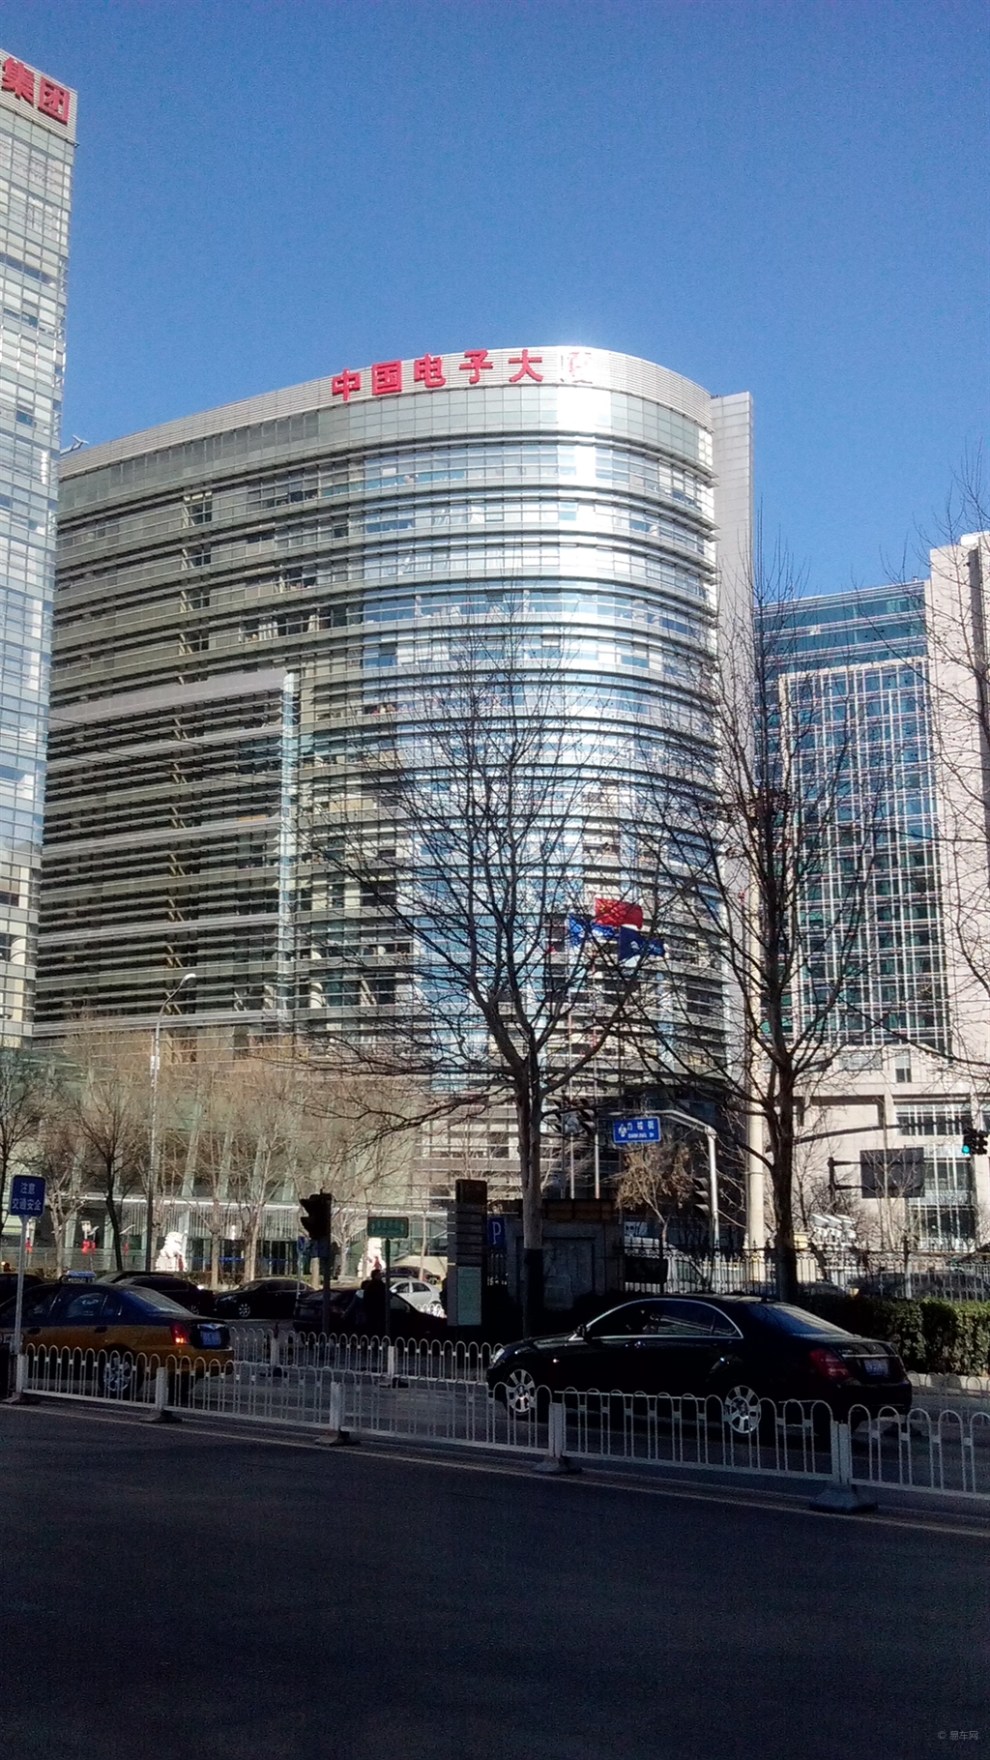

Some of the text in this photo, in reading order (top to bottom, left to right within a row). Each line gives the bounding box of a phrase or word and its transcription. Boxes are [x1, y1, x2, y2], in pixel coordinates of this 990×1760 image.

[2, 57, 70, 126] 集团
[20, 1182, 36, 1195] 注意
[12, 1198, 42, 1211] 交通安全
[492, 1221, 502, 1246] P
